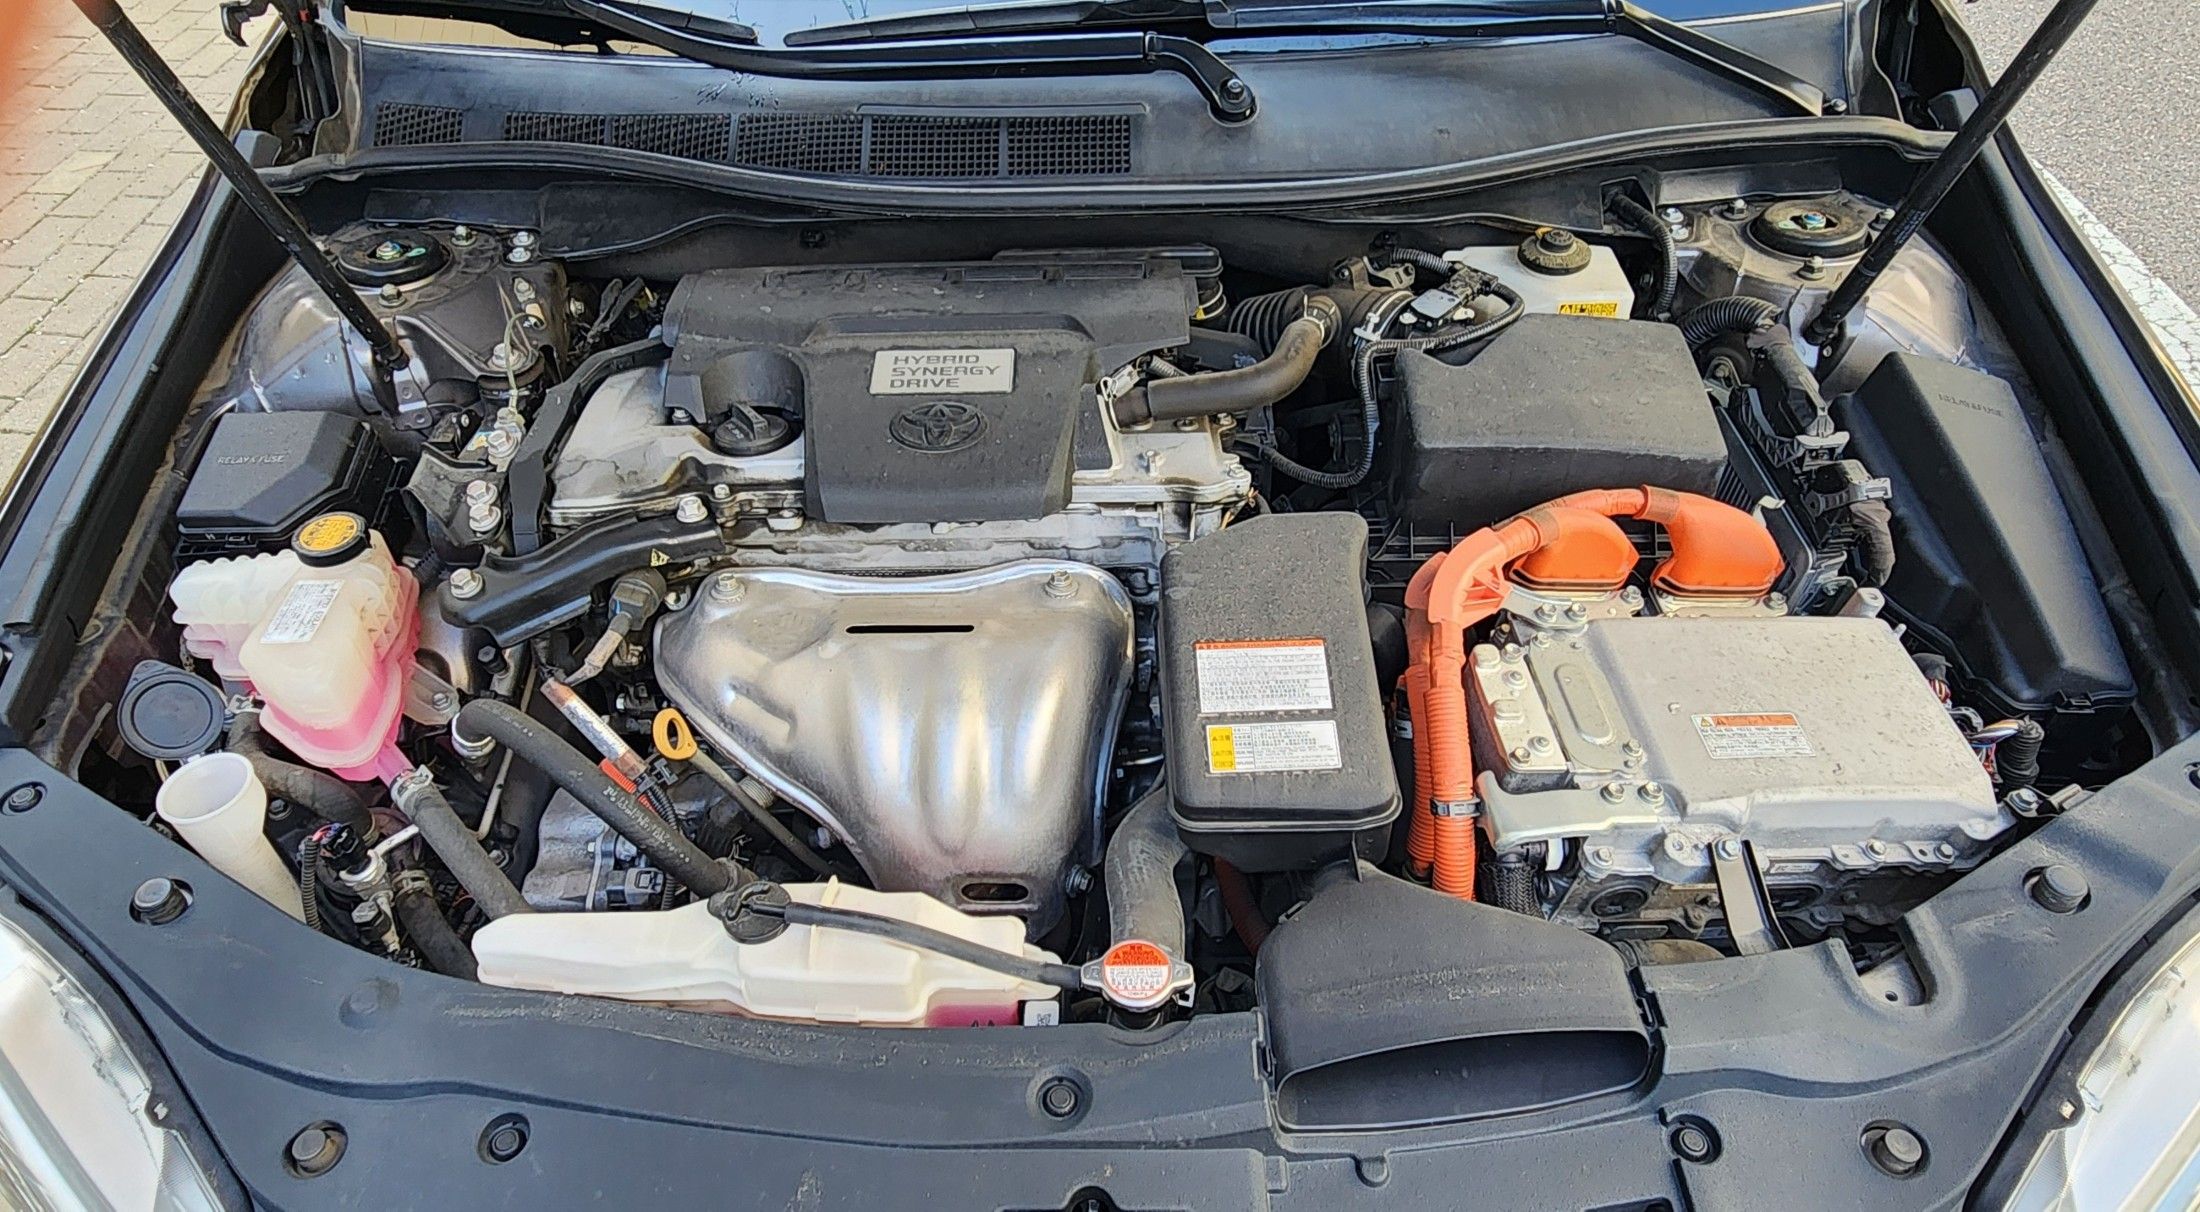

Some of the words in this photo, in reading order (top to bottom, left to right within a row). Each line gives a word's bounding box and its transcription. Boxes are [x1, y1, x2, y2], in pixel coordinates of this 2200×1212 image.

[893, 355, 980, 365] HYBRID
[891, 366, 1001, 377] SYNERGY
[889, 378, 960, 388] DRIVE
